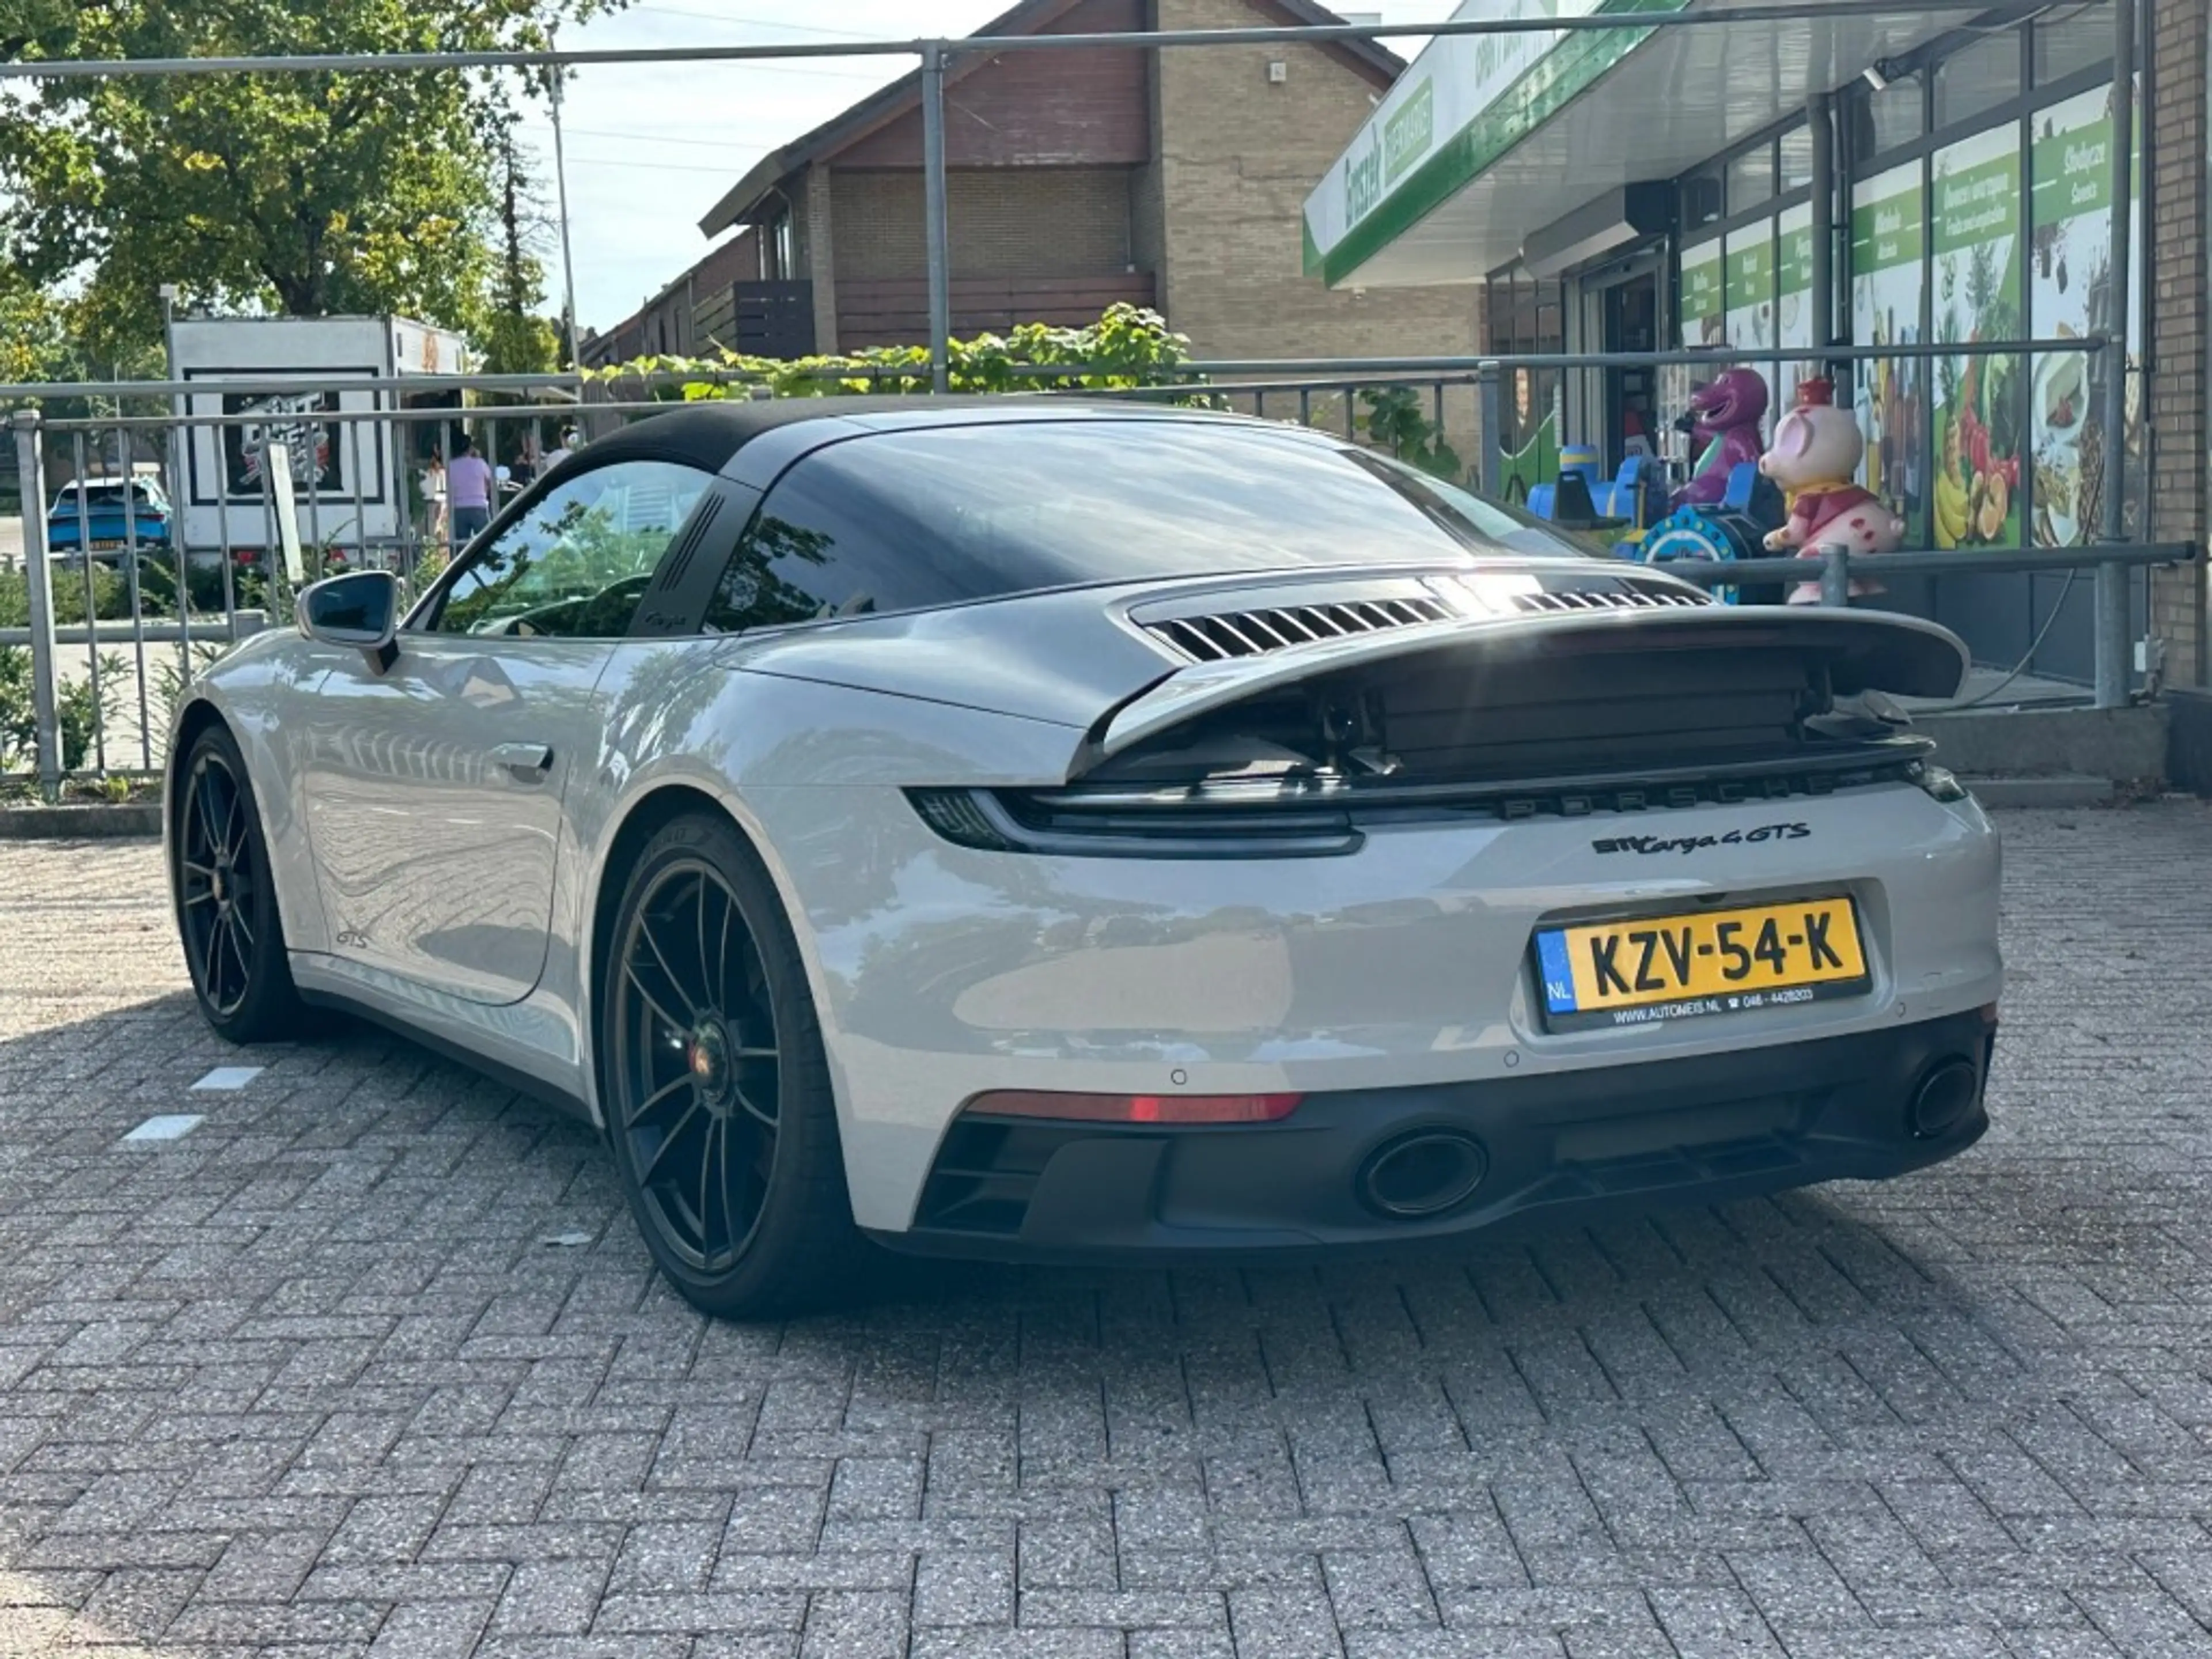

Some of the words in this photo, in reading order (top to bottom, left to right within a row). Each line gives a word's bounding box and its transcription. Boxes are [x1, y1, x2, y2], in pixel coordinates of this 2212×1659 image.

[1503, 774, 1834, 820] PORSCHE
[1637, 835, 1718, 855] Targa
[1721, 830, 1743, 843] 4
[1746, 823, 1812, 843] GTS
[1590, 912, 1843, 996] KZV-54-K
[1547, 982, 1572, 1000] NL
